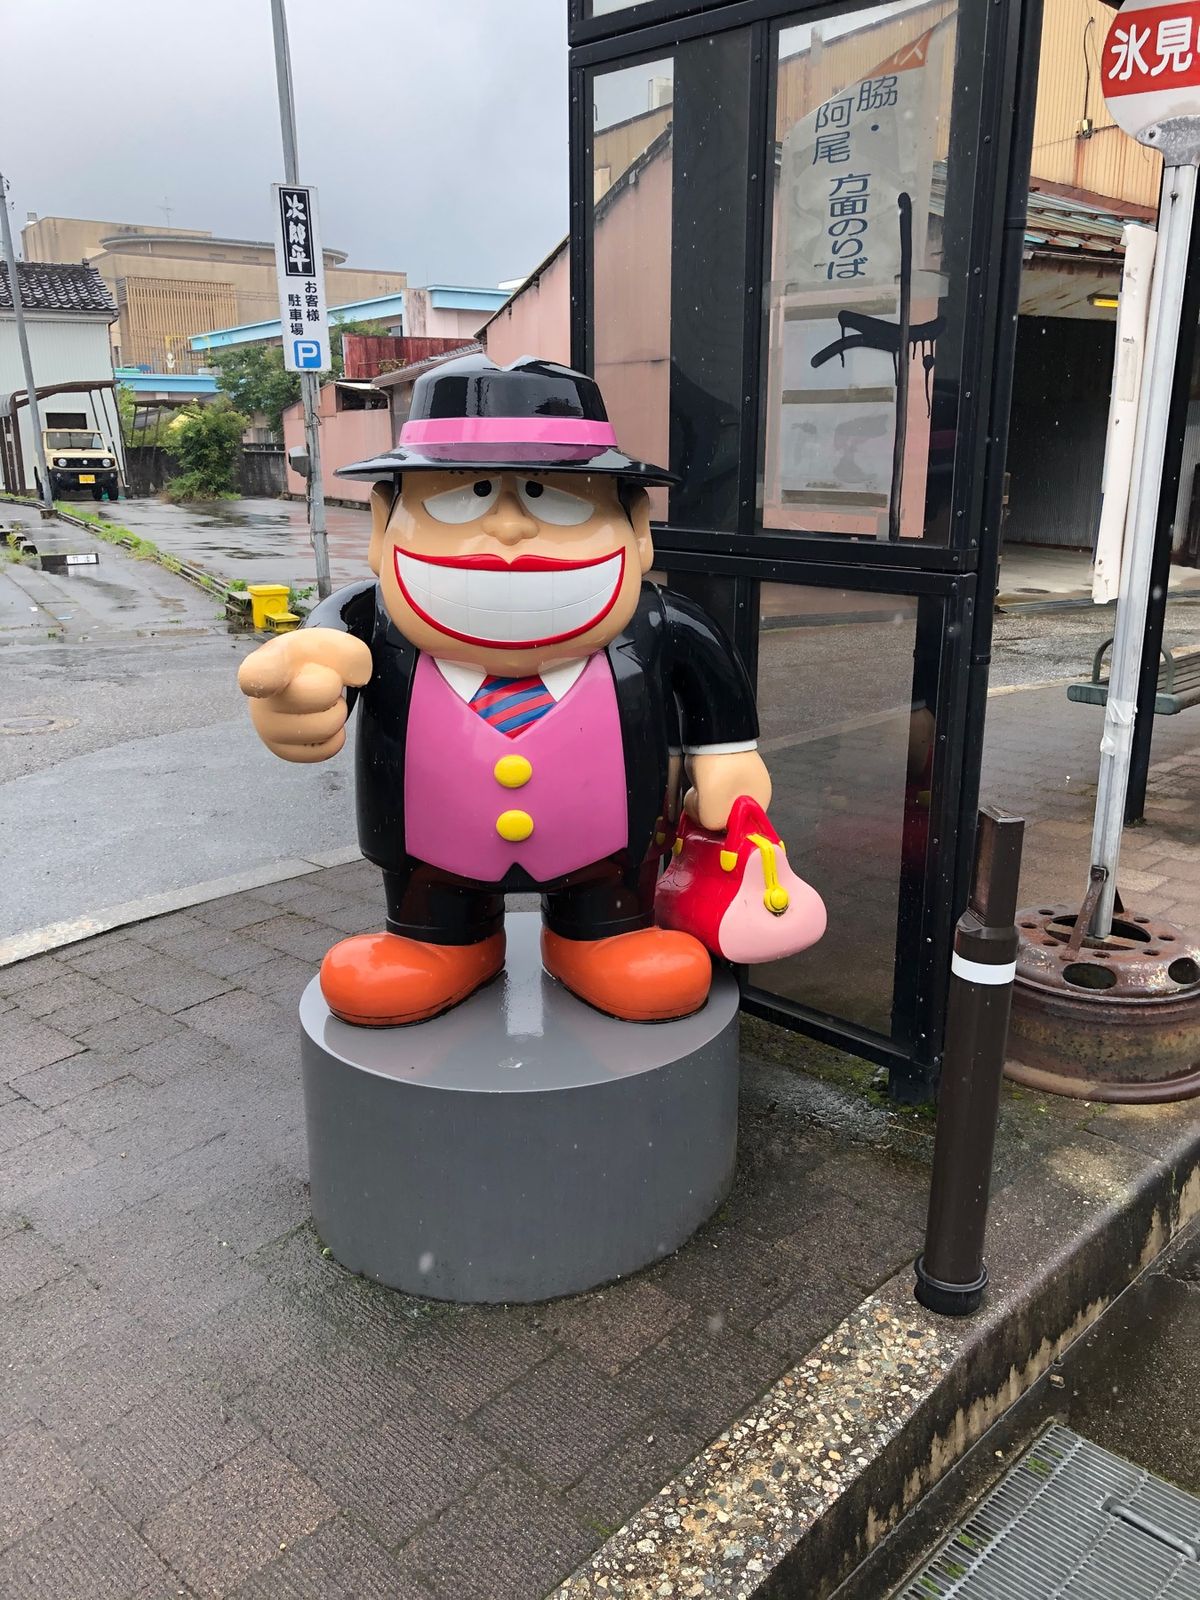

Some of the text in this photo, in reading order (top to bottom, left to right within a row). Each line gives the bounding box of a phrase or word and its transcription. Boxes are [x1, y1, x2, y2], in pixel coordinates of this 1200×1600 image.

[1108, 16, 1200, 80] 氷見
[812, 96, 856, 166] 阿尾
[827, 173, 872, 280] 方面のりば
[287, 293, 304, 336] 駐車場
[304, 280, 320, 322] お客様
[297, 342, 318, 367] P
